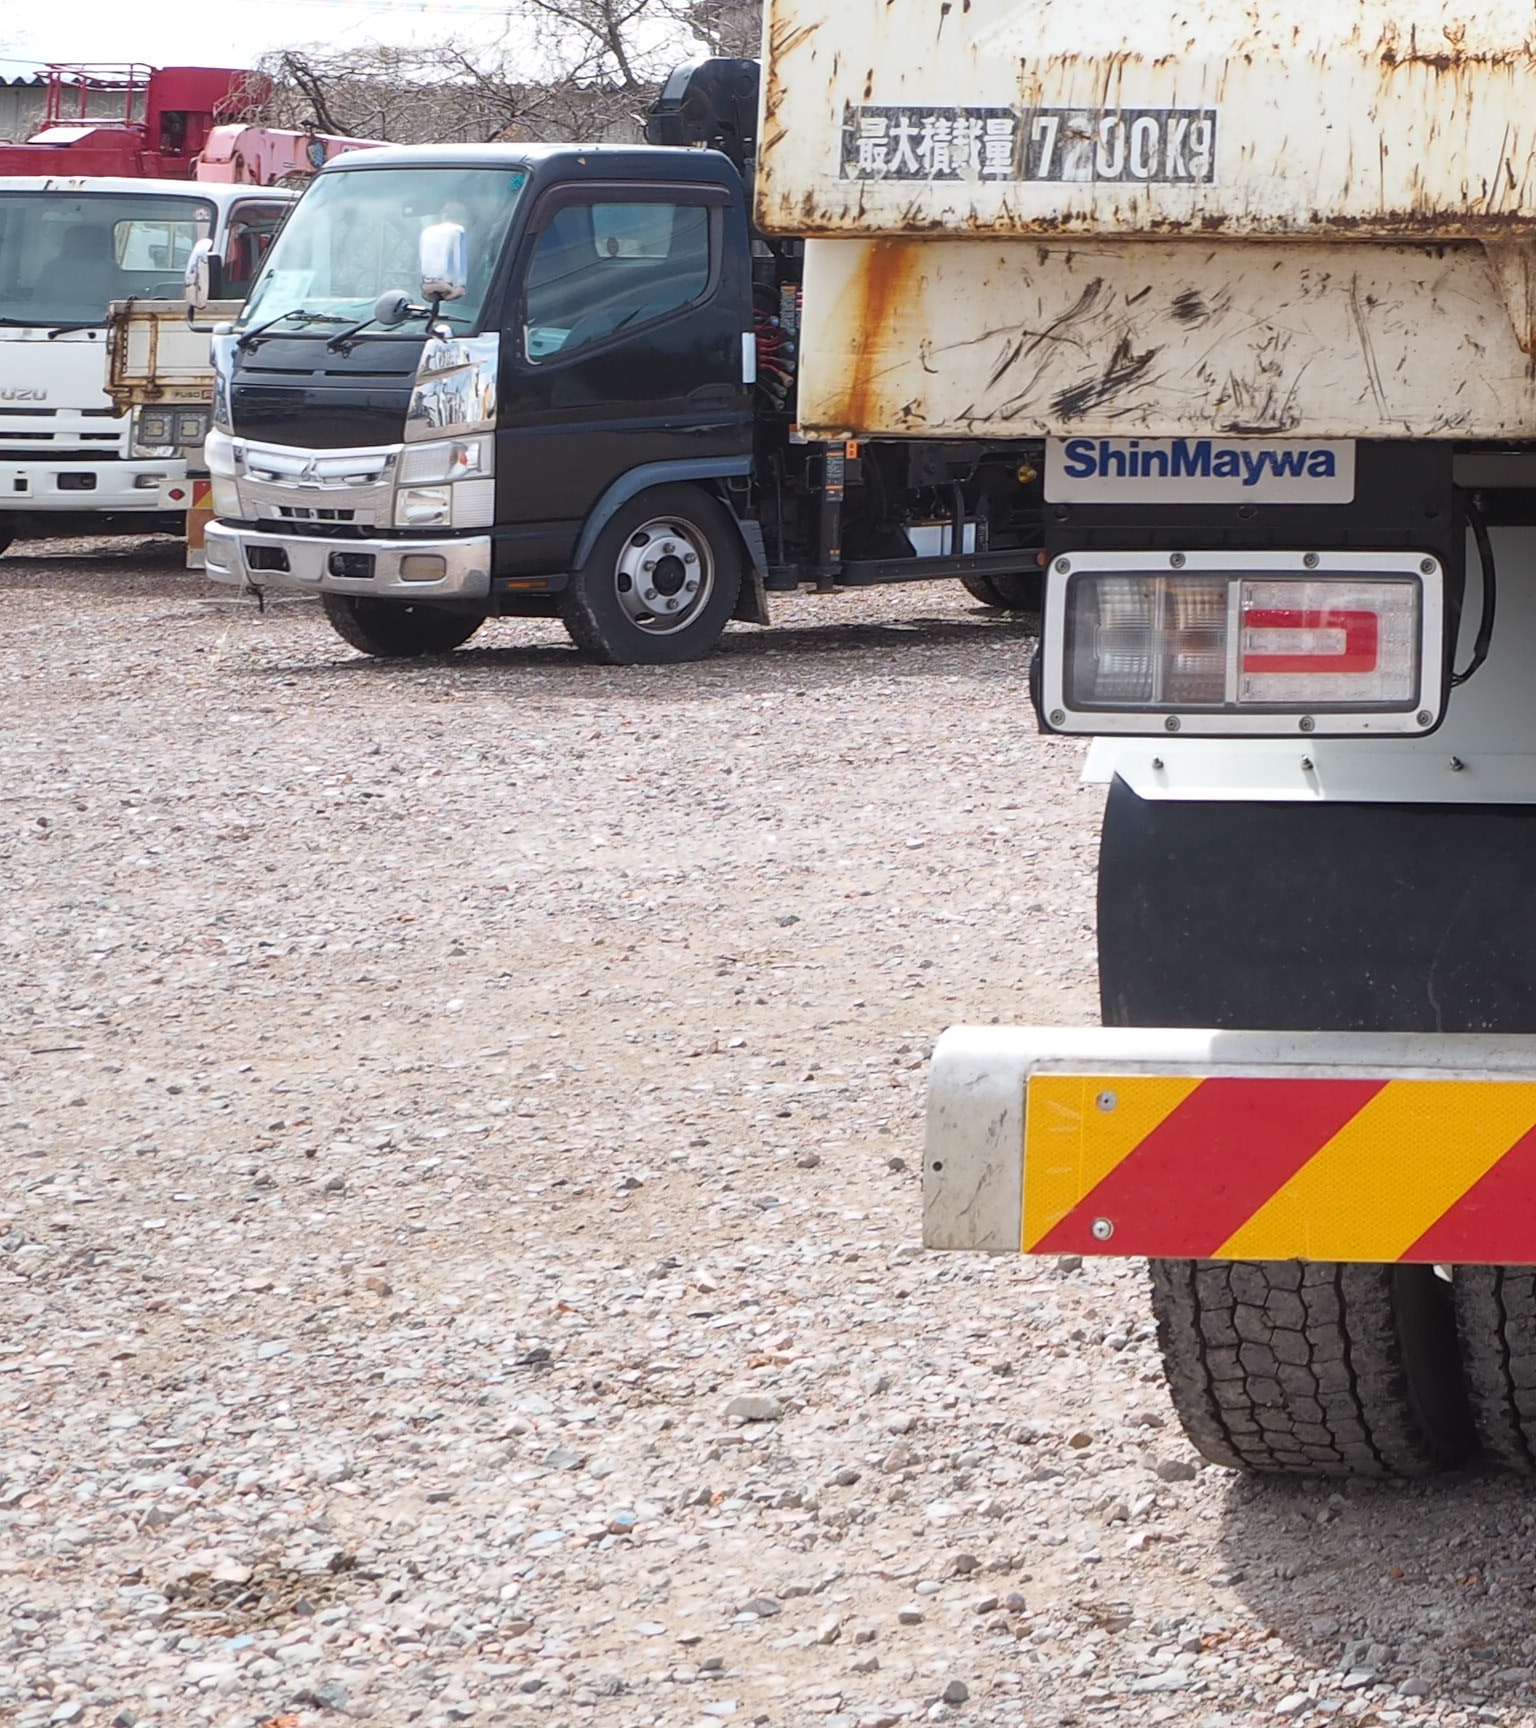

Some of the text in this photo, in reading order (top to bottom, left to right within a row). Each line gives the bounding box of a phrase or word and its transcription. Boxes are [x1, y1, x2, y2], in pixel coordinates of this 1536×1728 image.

[856, 116, 1015, 176] 最大積載量
[1063, 439, 1336, 486] ShinMaywa
